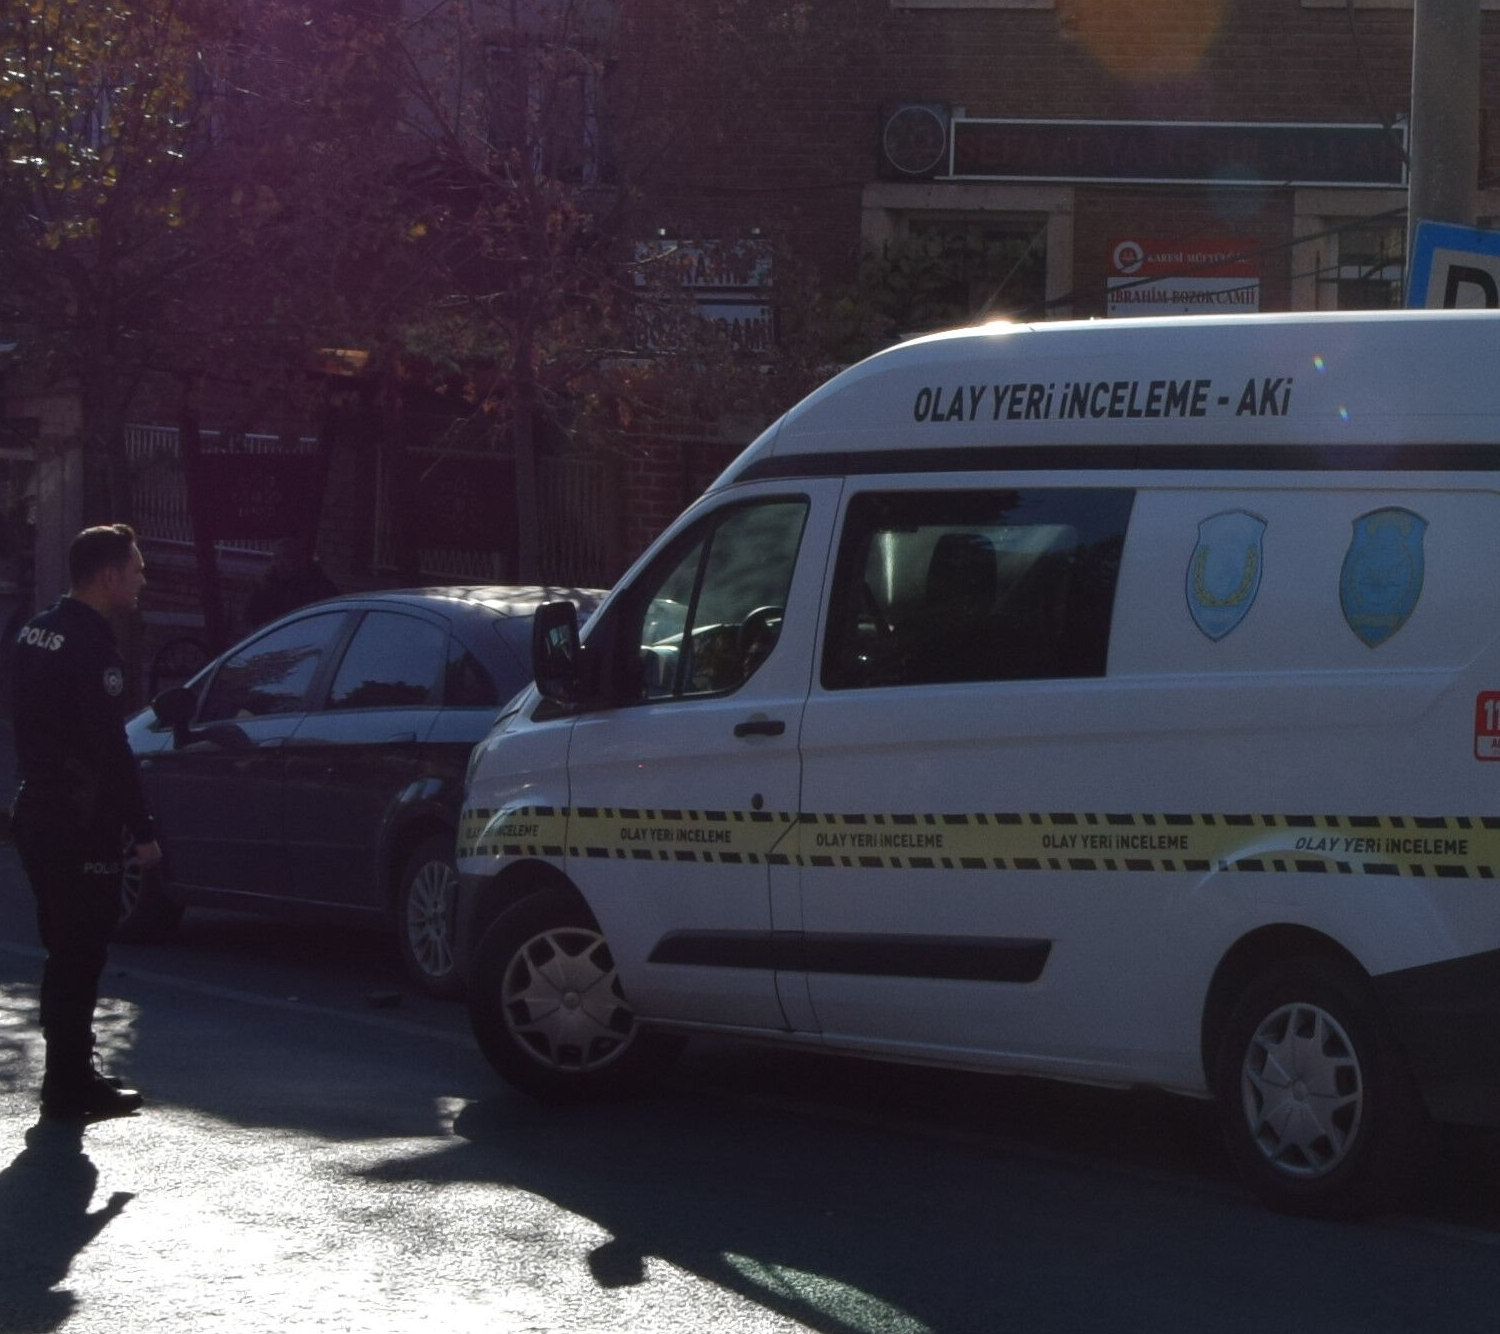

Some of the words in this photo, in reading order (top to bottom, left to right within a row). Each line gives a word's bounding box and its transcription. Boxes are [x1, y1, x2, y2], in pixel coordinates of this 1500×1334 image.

[913, 385, 988, 423] OLAY
[991, 383, 1055, 421] YERİ
[620, 827, 647, 841] OLAY
[816, 832, 847, 848] OLAY
[1042, 833, 1078, 849] OLAY
[1295, 835, 1339, 853] OLAY
